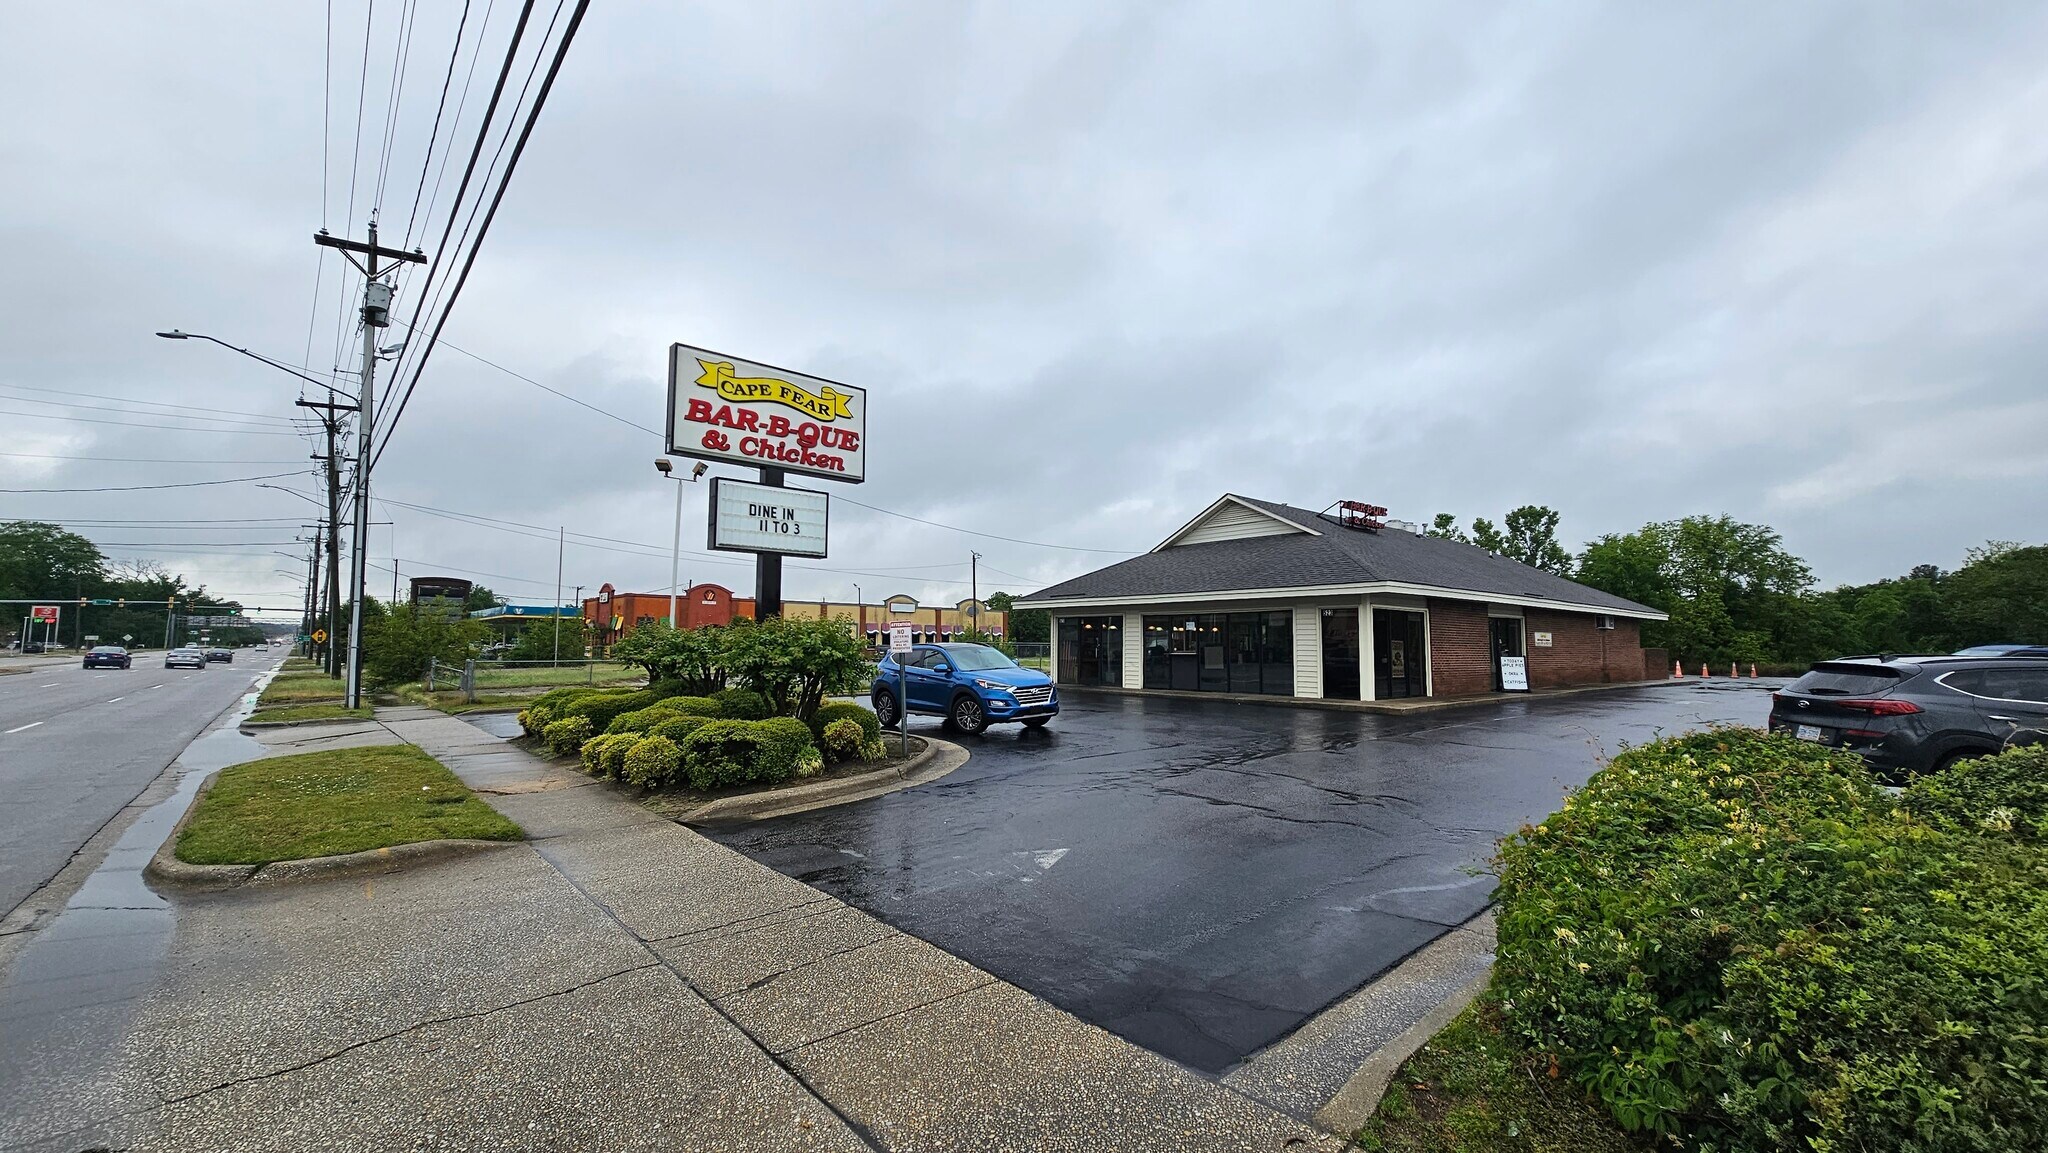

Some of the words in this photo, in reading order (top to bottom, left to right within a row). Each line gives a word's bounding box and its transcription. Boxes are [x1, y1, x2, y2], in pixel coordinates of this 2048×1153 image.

[720, 380, 772, 396] CAPE
[779, 385, 831, 417] FEAR
[684, 398, 860, 452] BAR-B-QUE
[701, 429, 730, 451] &
[739, 436, 845, 471] Chicken
[749, 503, 777, 519] DINE
[782, 507, 794, 521] IN
[759, 519, 768, 532] 11
[773, 520, 789, 534] TO
[793, 523, 800, 535] 3
